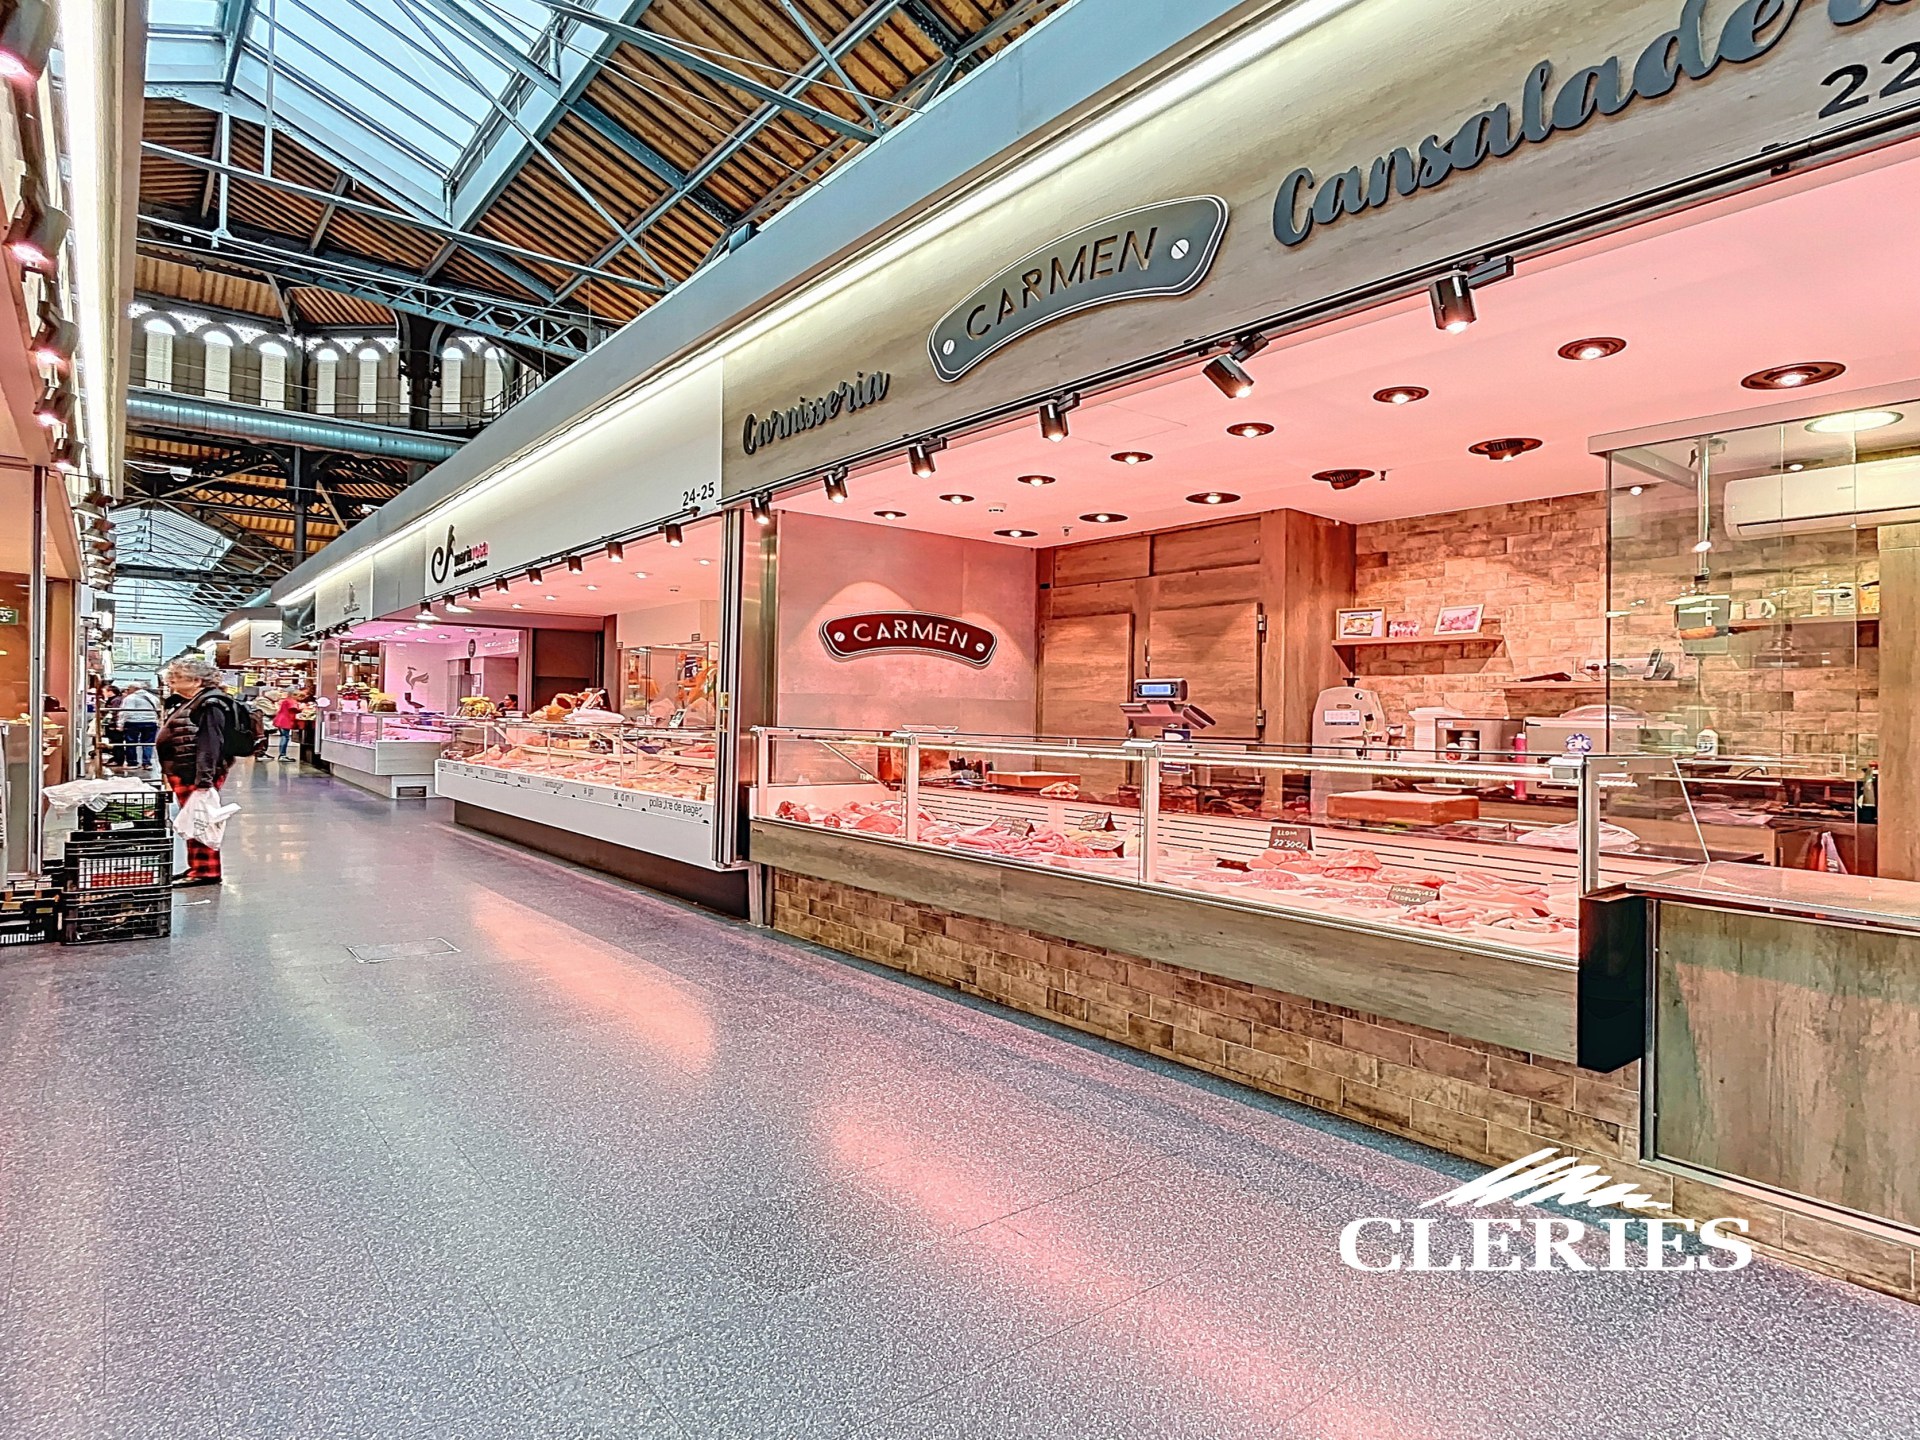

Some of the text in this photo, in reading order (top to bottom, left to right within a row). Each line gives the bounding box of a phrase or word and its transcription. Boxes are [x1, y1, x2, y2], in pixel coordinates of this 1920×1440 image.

[966, 226, 1158, 341] CARMEN
[743, 371, 891, 455] Carnisseria
[683, 481, 715, 506] 24-25
[853, 619, 968, 649] CARMEN
